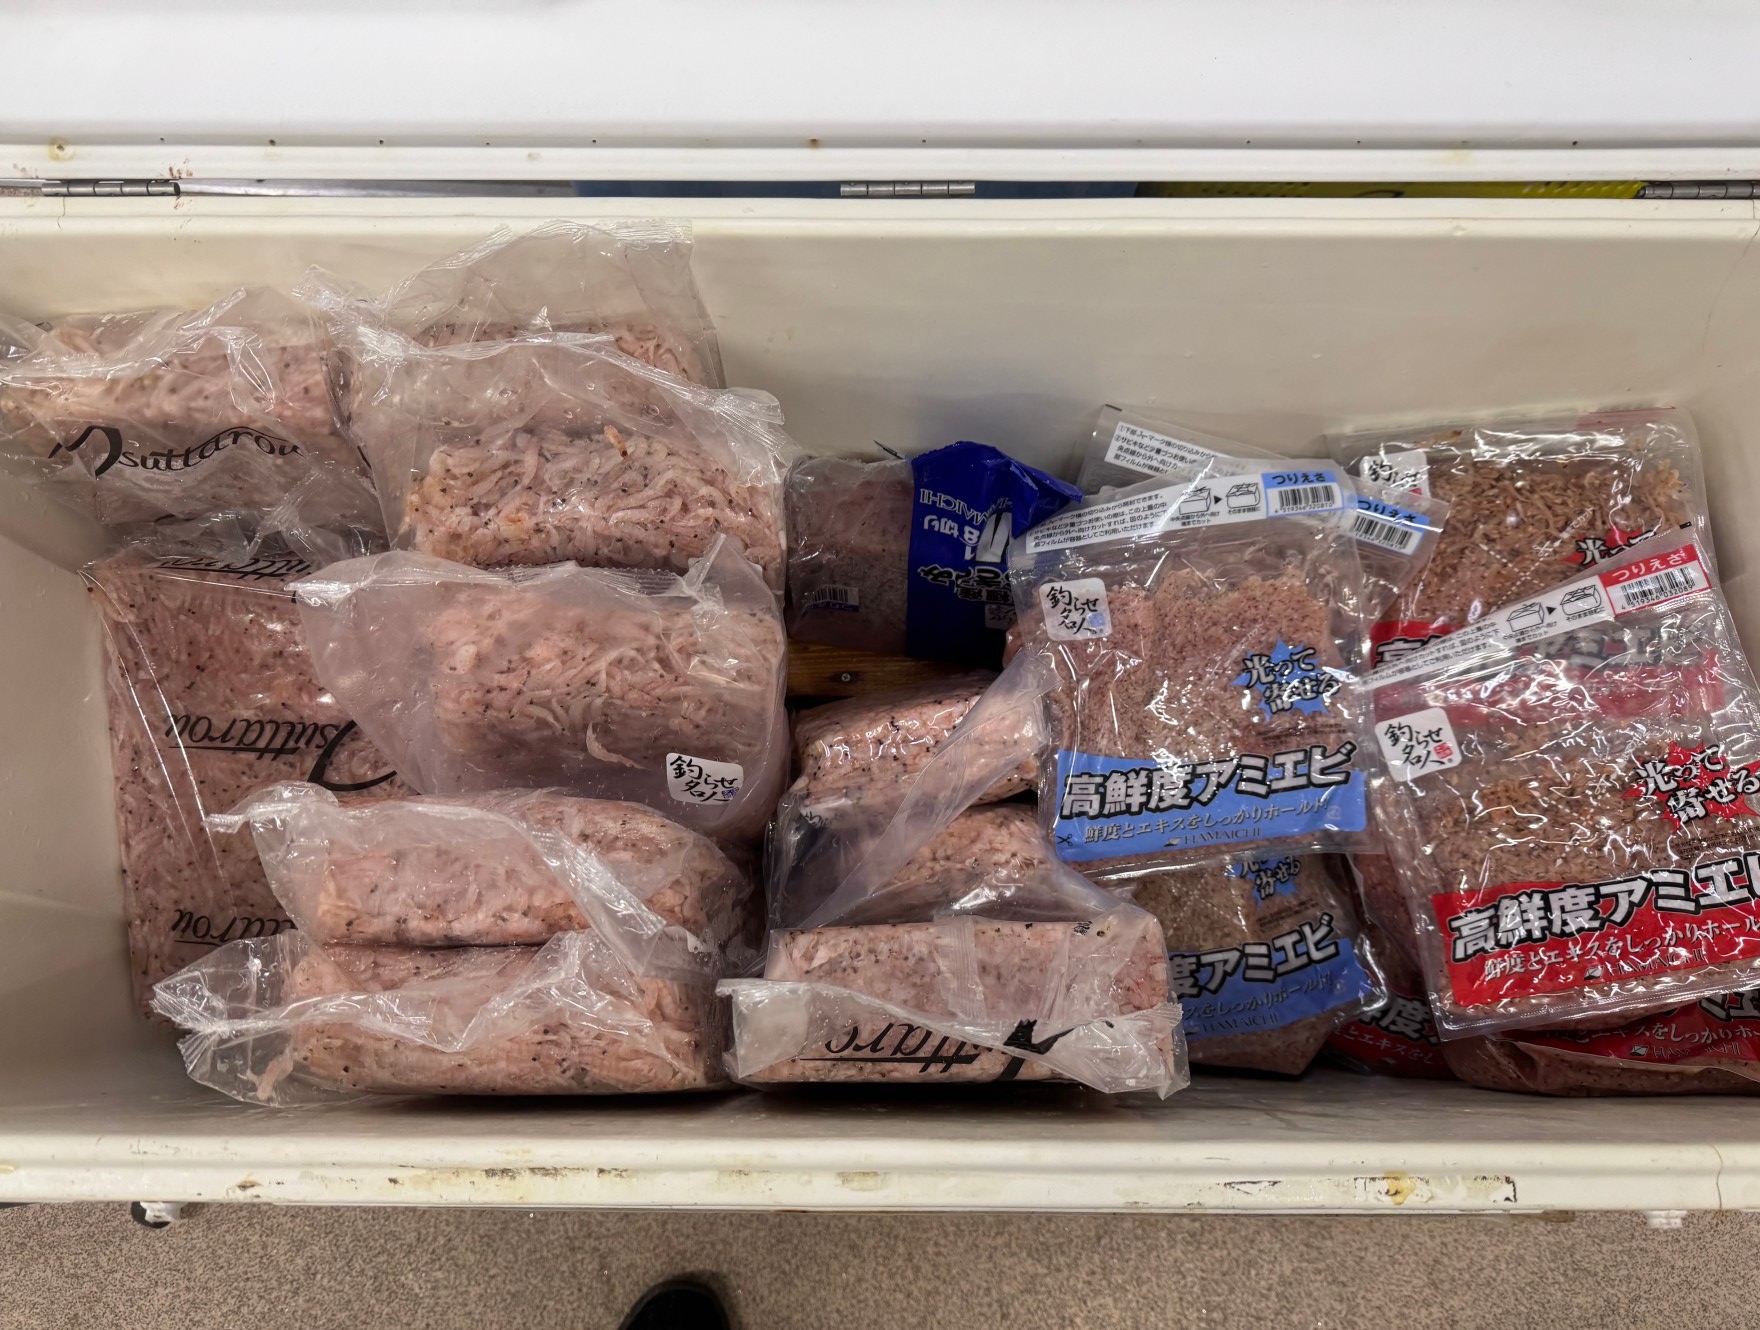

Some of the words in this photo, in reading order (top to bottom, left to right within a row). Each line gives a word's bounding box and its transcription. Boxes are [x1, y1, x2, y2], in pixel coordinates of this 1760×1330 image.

[1272, 472, 1326, 485] つりえさ
[1629, 594, 1660, 608] 519346
[1662, 585, 1693, 599] 032089
[1242, 647, 1316, 689] 光って
[1384, 722, 1443, 749] 釣らせ
[1059, 741, 1357, 819] 高鮮度アミエビ
[1635, 744, 1725, 796] 光って
[1169, 912, 1341, 1000] 度アミエビ
